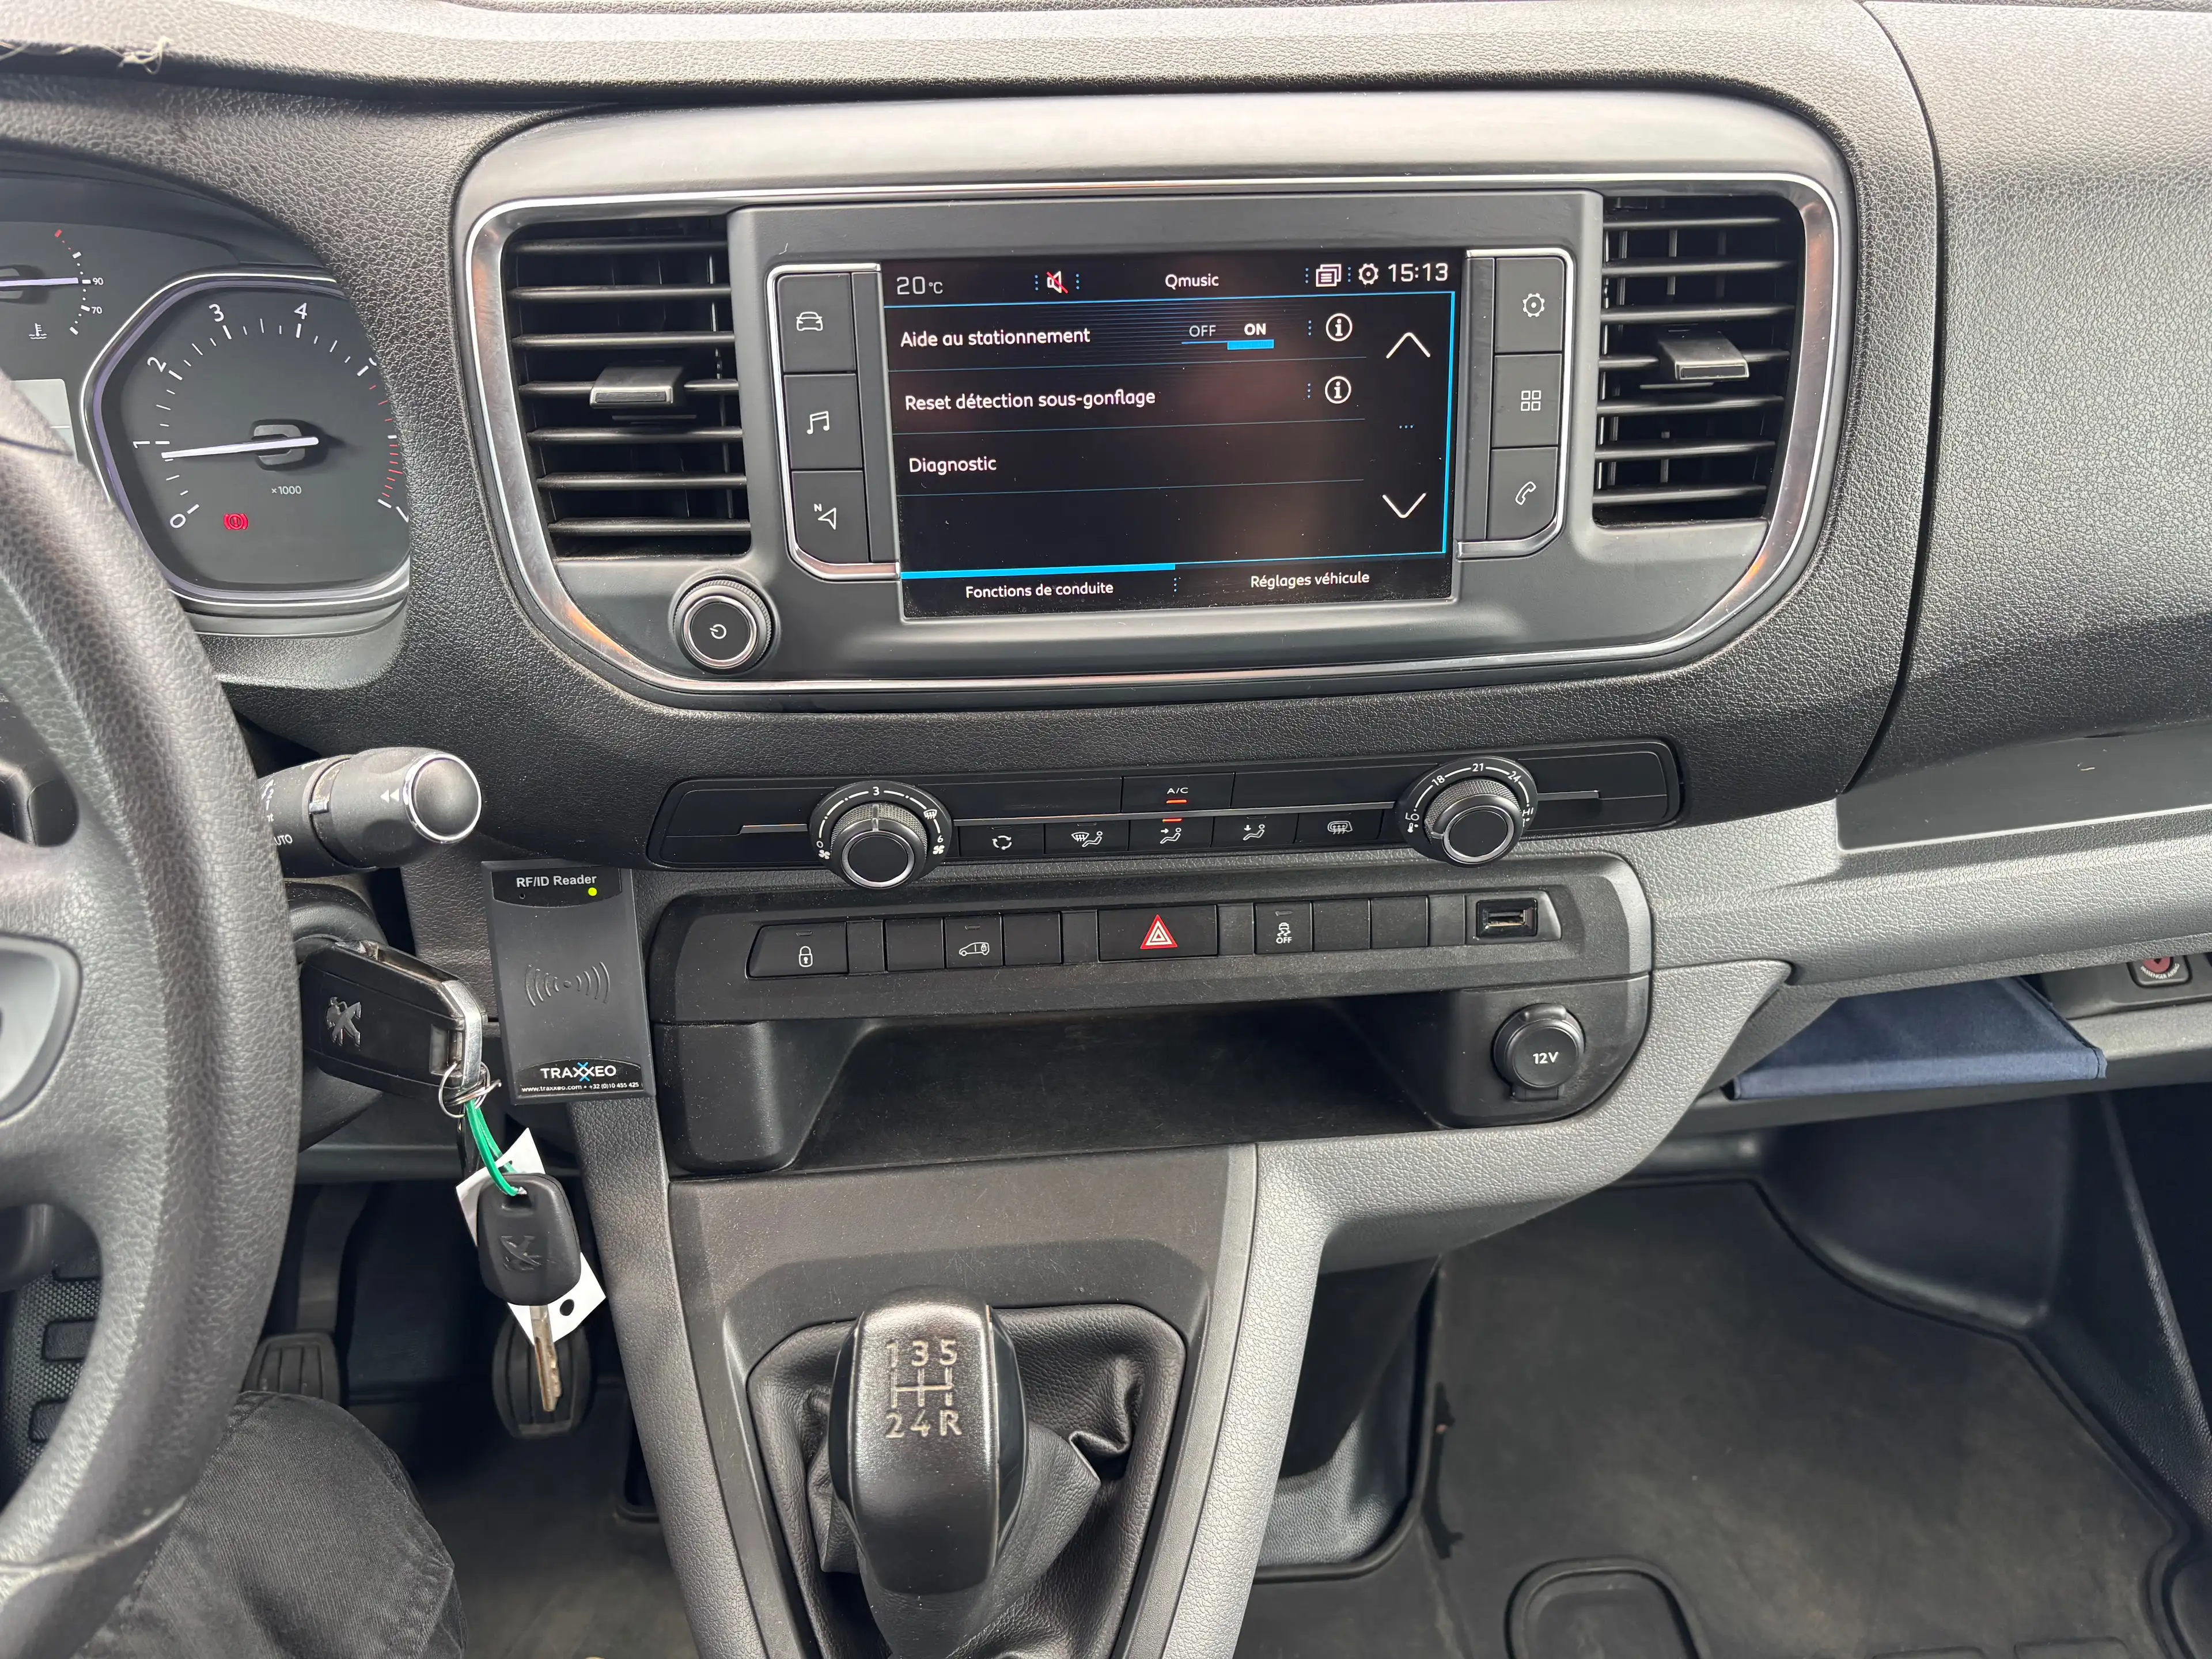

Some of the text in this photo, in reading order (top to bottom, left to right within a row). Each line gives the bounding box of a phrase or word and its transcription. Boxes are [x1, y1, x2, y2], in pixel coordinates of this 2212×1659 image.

[1388, 263, 1449, 283] 15:13
[92, 277, 104, 286] 90
[1165, 273, 1219, 290] Qmusic
[91, 306, 103, 315] 70
[209, 304, 224, 322] 3
[294, 302, 308, 320] 4
[1189, 324, 1217, 338] OFF
[1244, 323, 1266, 336] ON
[900, 328, 1090, 347] Aide au stationnement
[147, 357, 167, 373] 2
[905, 388, 1156, 411] Reset détection sous-gonflage
[132, 440, 150, 449] 1
[909, 455, 997, 476] Diagnostic
[813, 503, 823, 512] N
[169, 513, 187, 528] 0
[1250, 570, 1370, 591] Réglages véhicule
[965, 581, 1114, 599] Fonctions de conduite
[1472, 763, 1484, 772] 21
[1431, 775, 1445, 786] 18
[1507, 771, 1522, 783] 24
[267, 789, 274, 799] 2
[873, 786, 880, 796] 3
[1166, 787, 1189, 795] A/C
[1405, 812, 1419, 821] LO
[1522, 807, 1534, 817] HI
[274, 834, 293, 846] UTO
[937, 835, 944, 843] 6
[516, 874, 597, 888] RF/ID Reader
[1532, 1051, 1559, 1065] 12V
[540, 1062, 616, 1082] TRAXXEO
[521, 1084, 582, 1093] www.traxxeo.com
[886, 1338, 958, 1369] 1 3 5
[885, 1409, 963, 1440] 2 4 R
